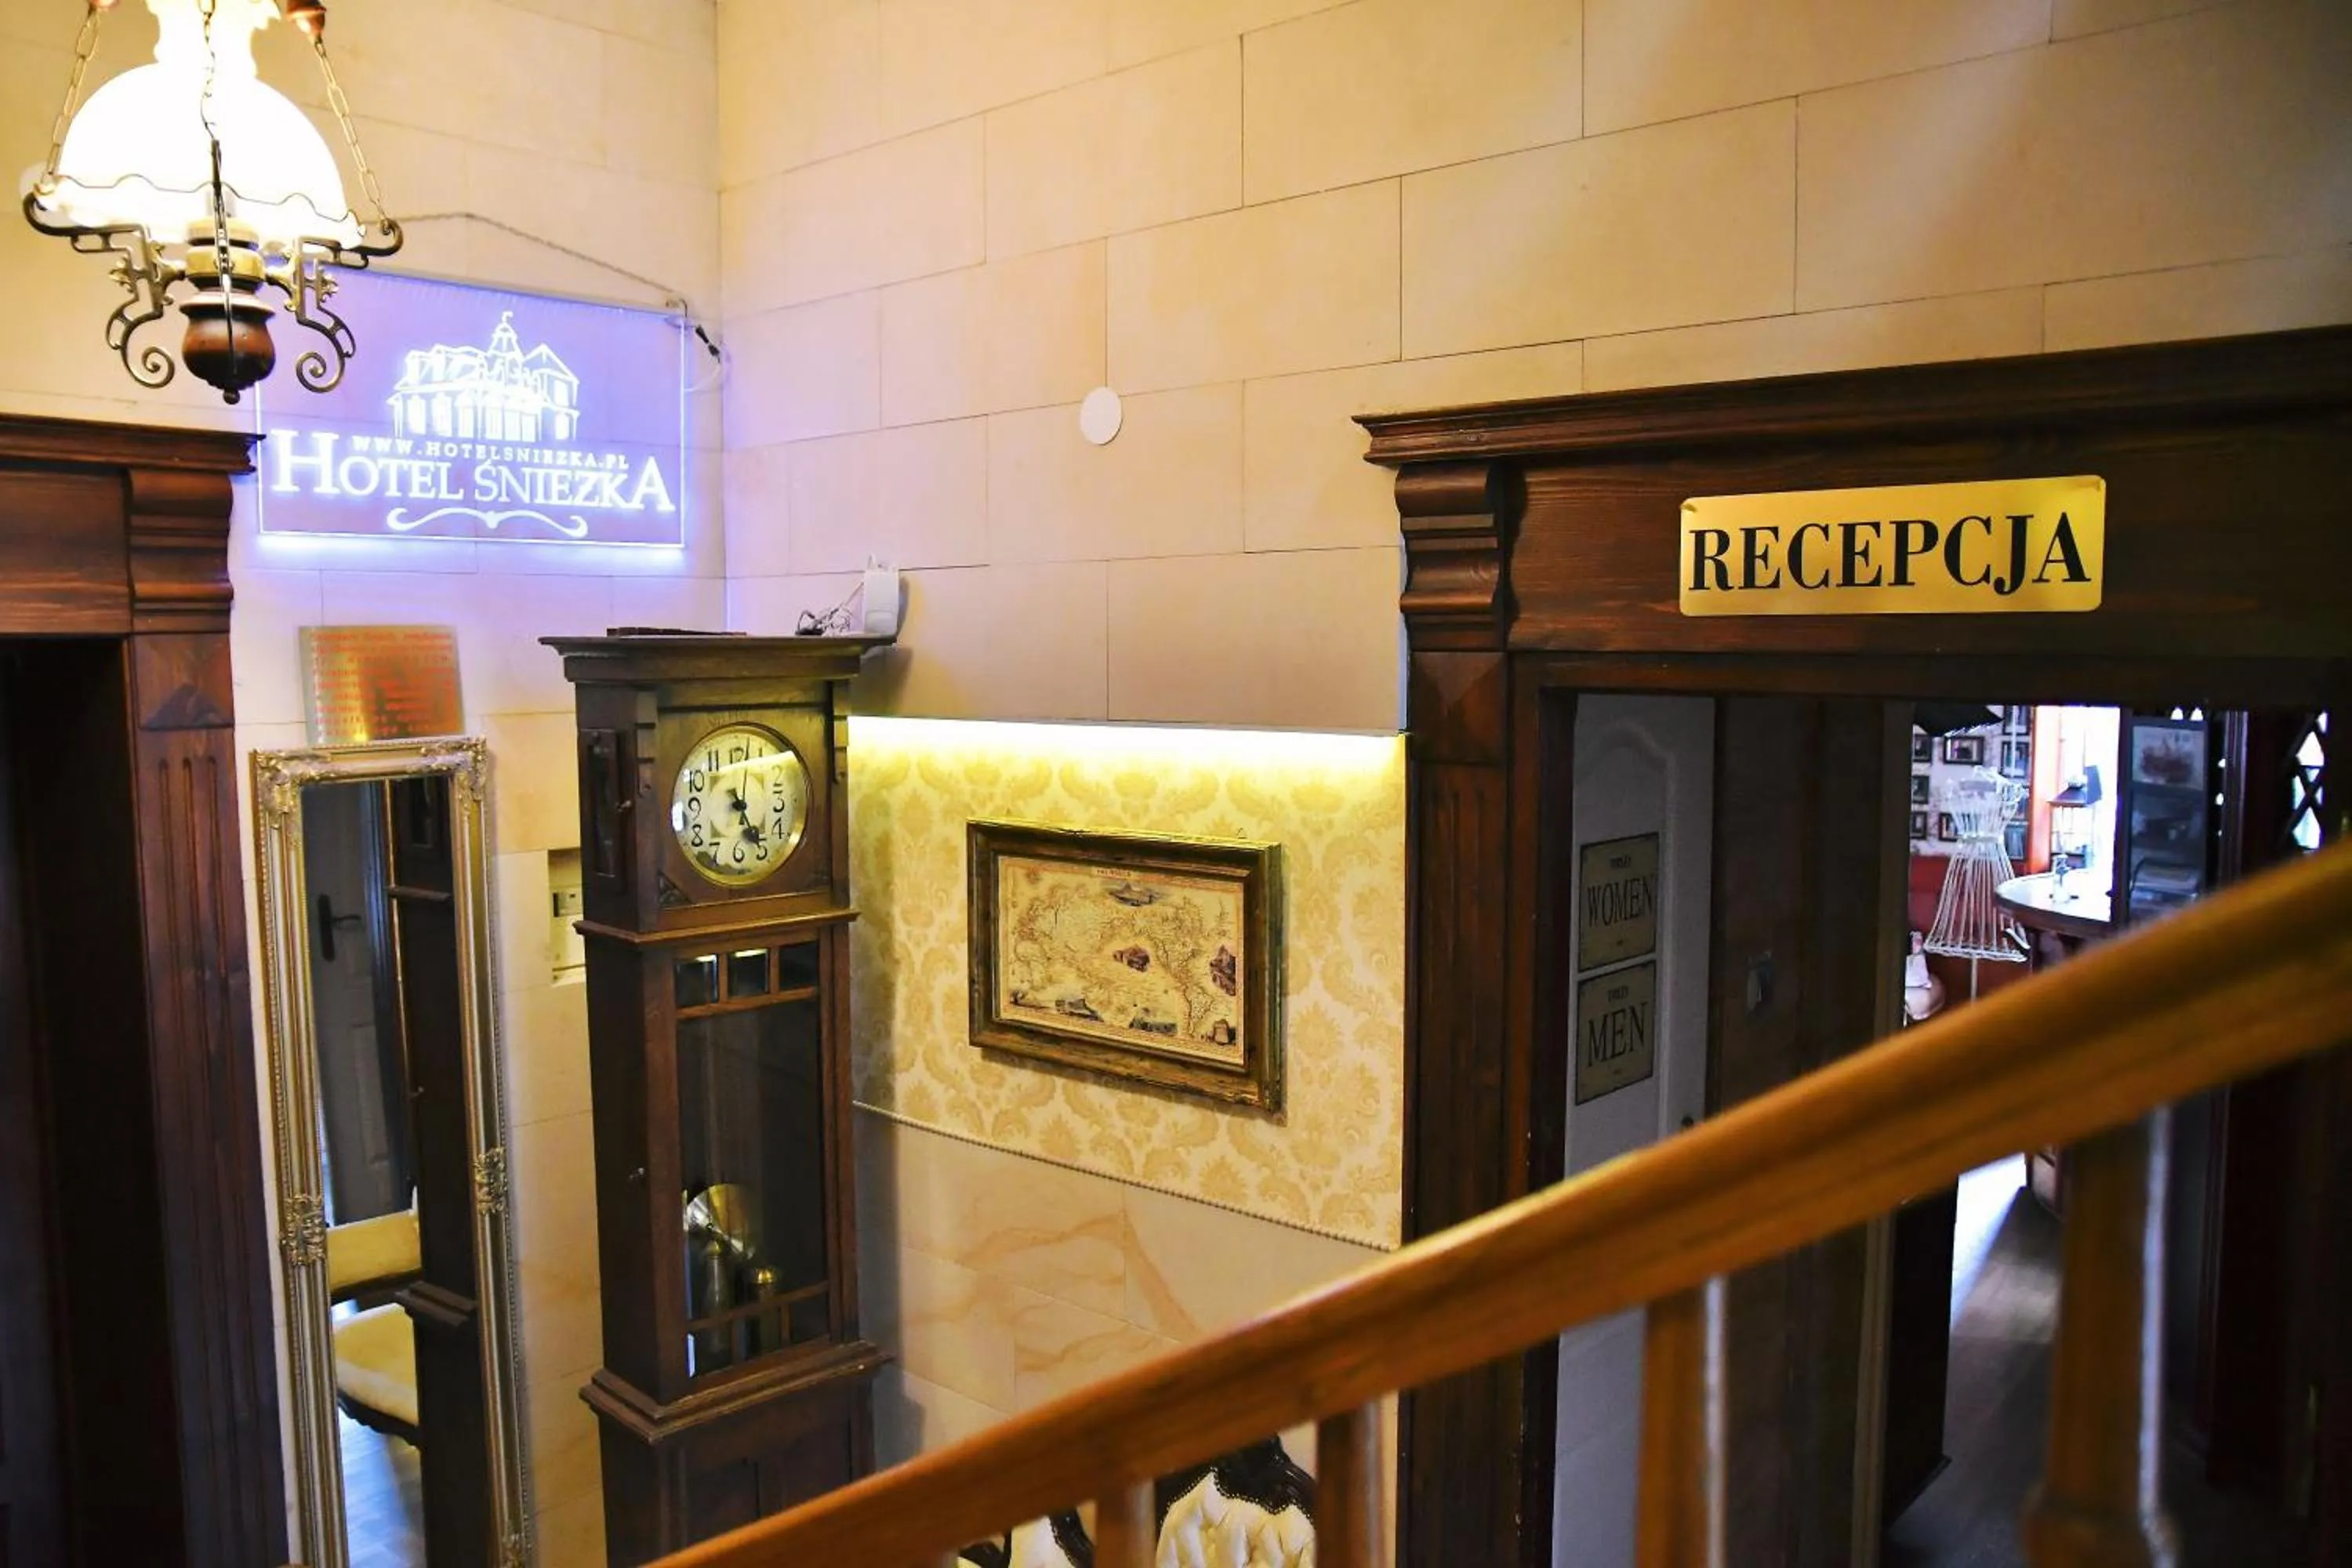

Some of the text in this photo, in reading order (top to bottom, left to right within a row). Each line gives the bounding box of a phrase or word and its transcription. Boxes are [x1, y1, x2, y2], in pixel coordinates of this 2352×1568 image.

[1688, 511, 2092, 596] RECEPCJA
[708, 749, 719, 772] 11
[689, 770, 705, 793] 10
[771, 764, 783, 787] 2
[688, 797, 702, 820] 9
[772, 789, 785, 813] 3
[691, 824, 704, 848] 8
[771, 817, 785, 840] 4
[709, 841, 720, 866] 7
[733, 840, 745, 863] 6
[756, 837, 768, 861] 5
[1587, 873, 1654, 928] WOMEN
[1587, 1000, 1648, 1068] MEN
